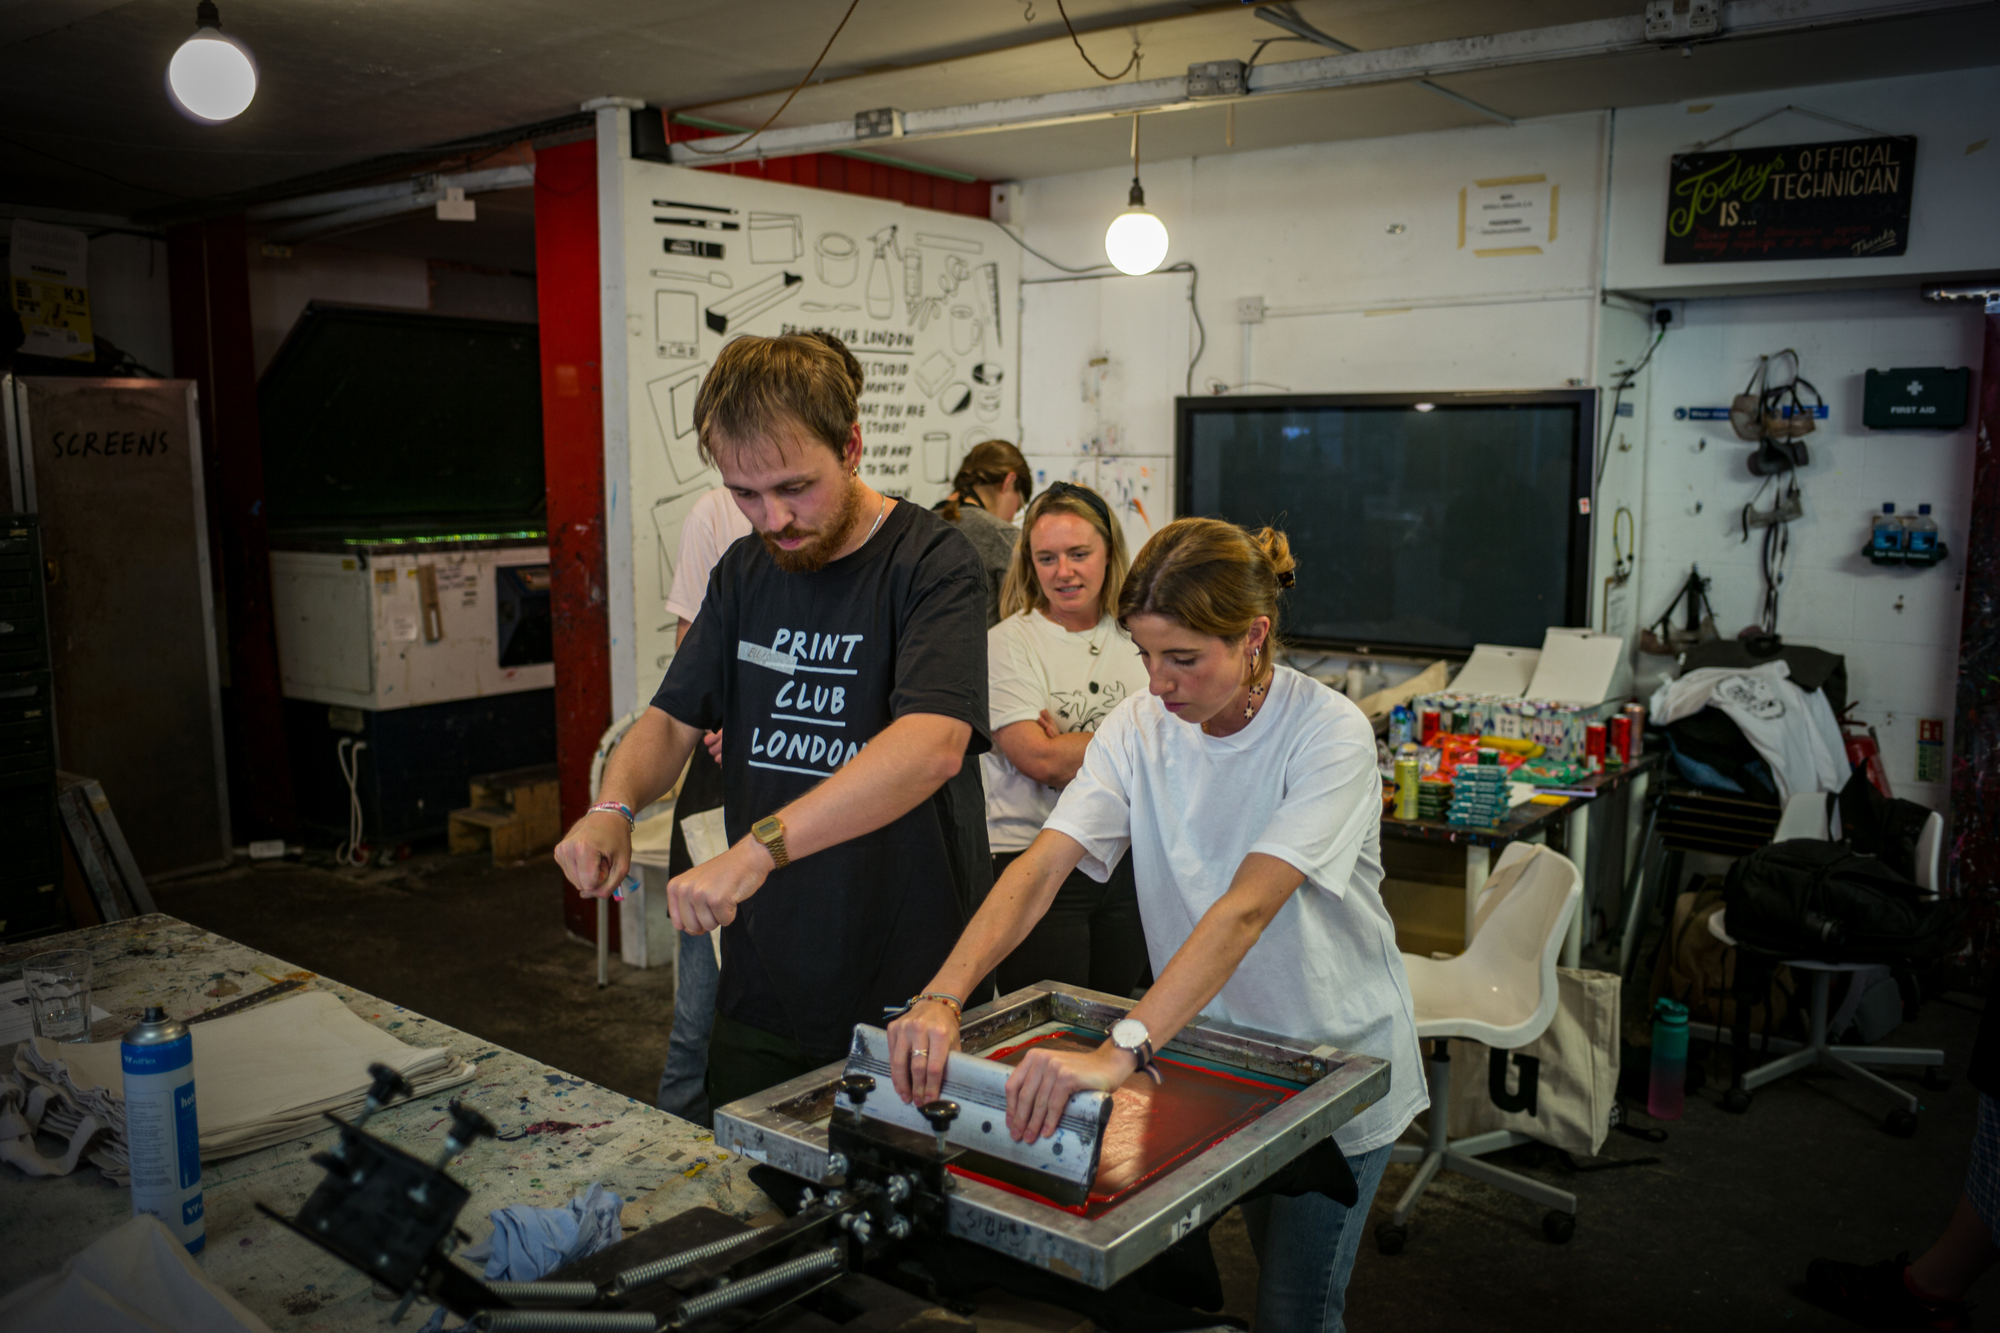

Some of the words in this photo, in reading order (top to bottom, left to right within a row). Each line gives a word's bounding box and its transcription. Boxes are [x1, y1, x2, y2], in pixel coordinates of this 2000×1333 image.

[1799, 144, 1900, 171] OFFICIAL
[1770, 166, 1900, 200] TECHNICIAN
[863, 329, 914, 347] LONDON
[871, 362, 909, 377] STUDIO
[865, 382, 906, 395] MONTH
[1890, 406, 1917, 414] FIRST
[1918, 406, 1937, 414] AID
[53, 431, 168, 458] SCREENS
[771, 628, 863, 663] PRINT
[775, 680, 845, 715] CLUB
